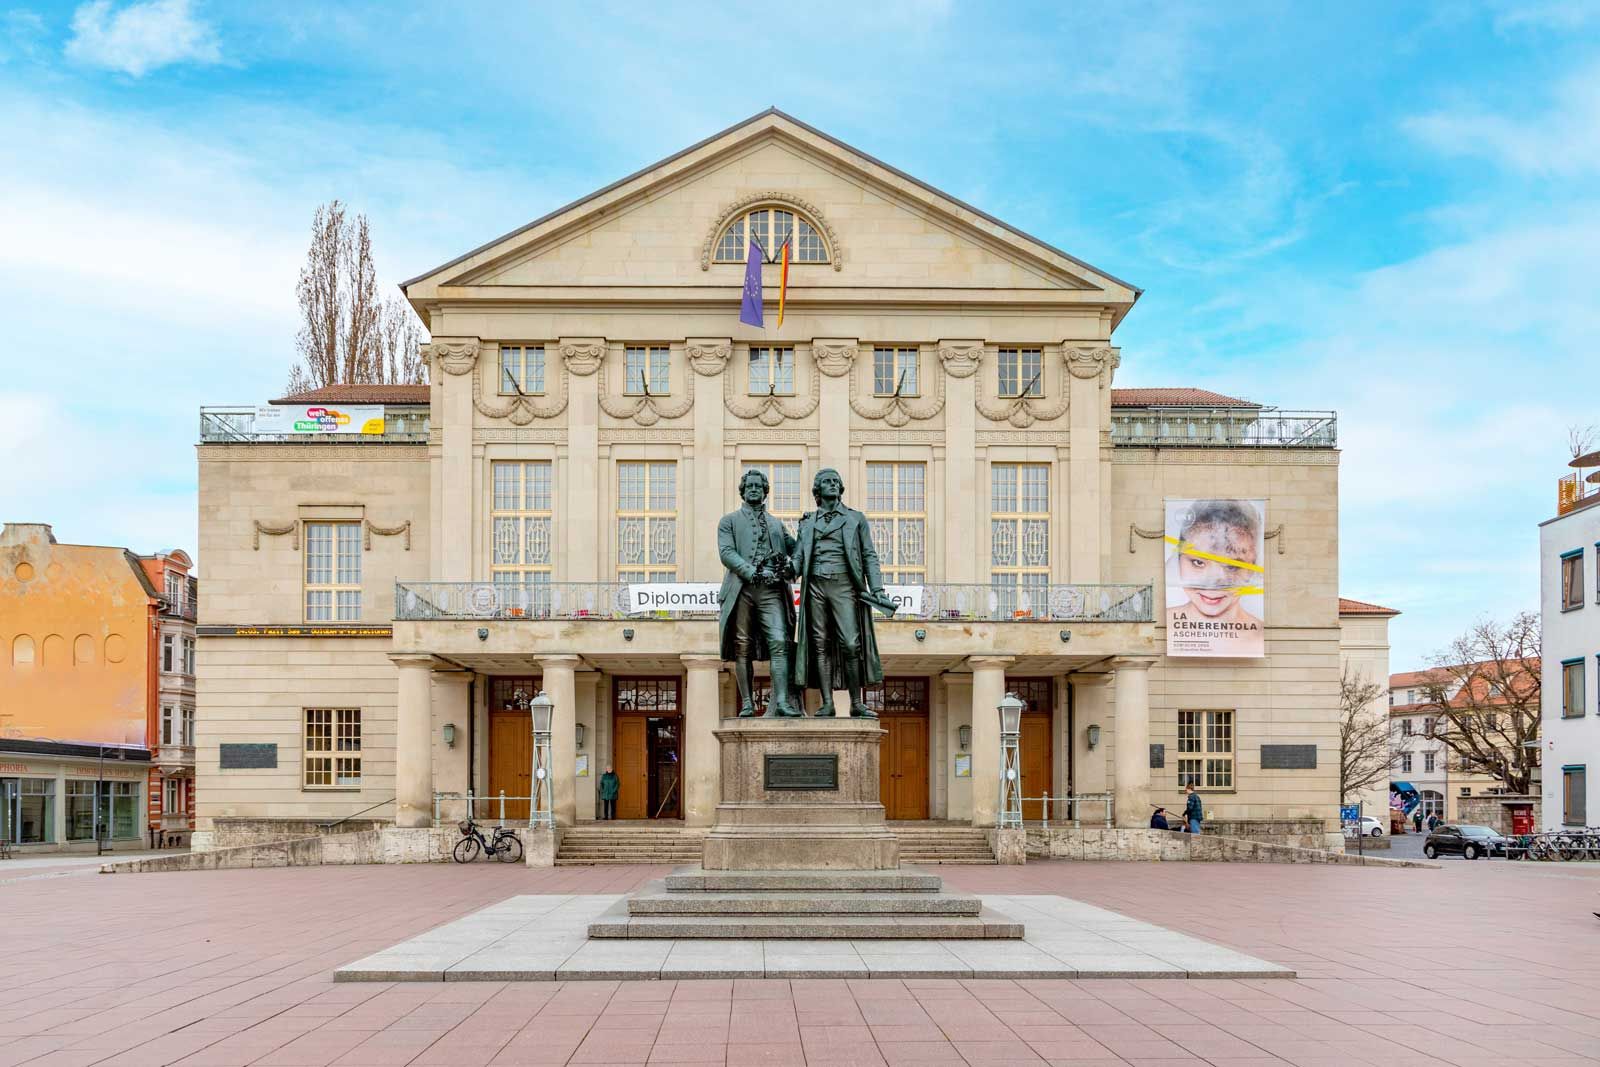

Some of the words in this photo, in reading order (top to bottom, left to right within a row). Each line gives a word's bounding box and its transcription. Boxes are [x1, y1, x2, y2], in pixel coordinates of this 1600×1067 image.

[308, 409, 326, 418] welt
[320, 415, 349, 424] offenes
[297, 422, 337, 431] Thüringen
[637, 592, 719, 607] Diplomati
[1173, 612, 1187, 620] LA
[1173, 622, 1258, 631] CENERENTOLA
